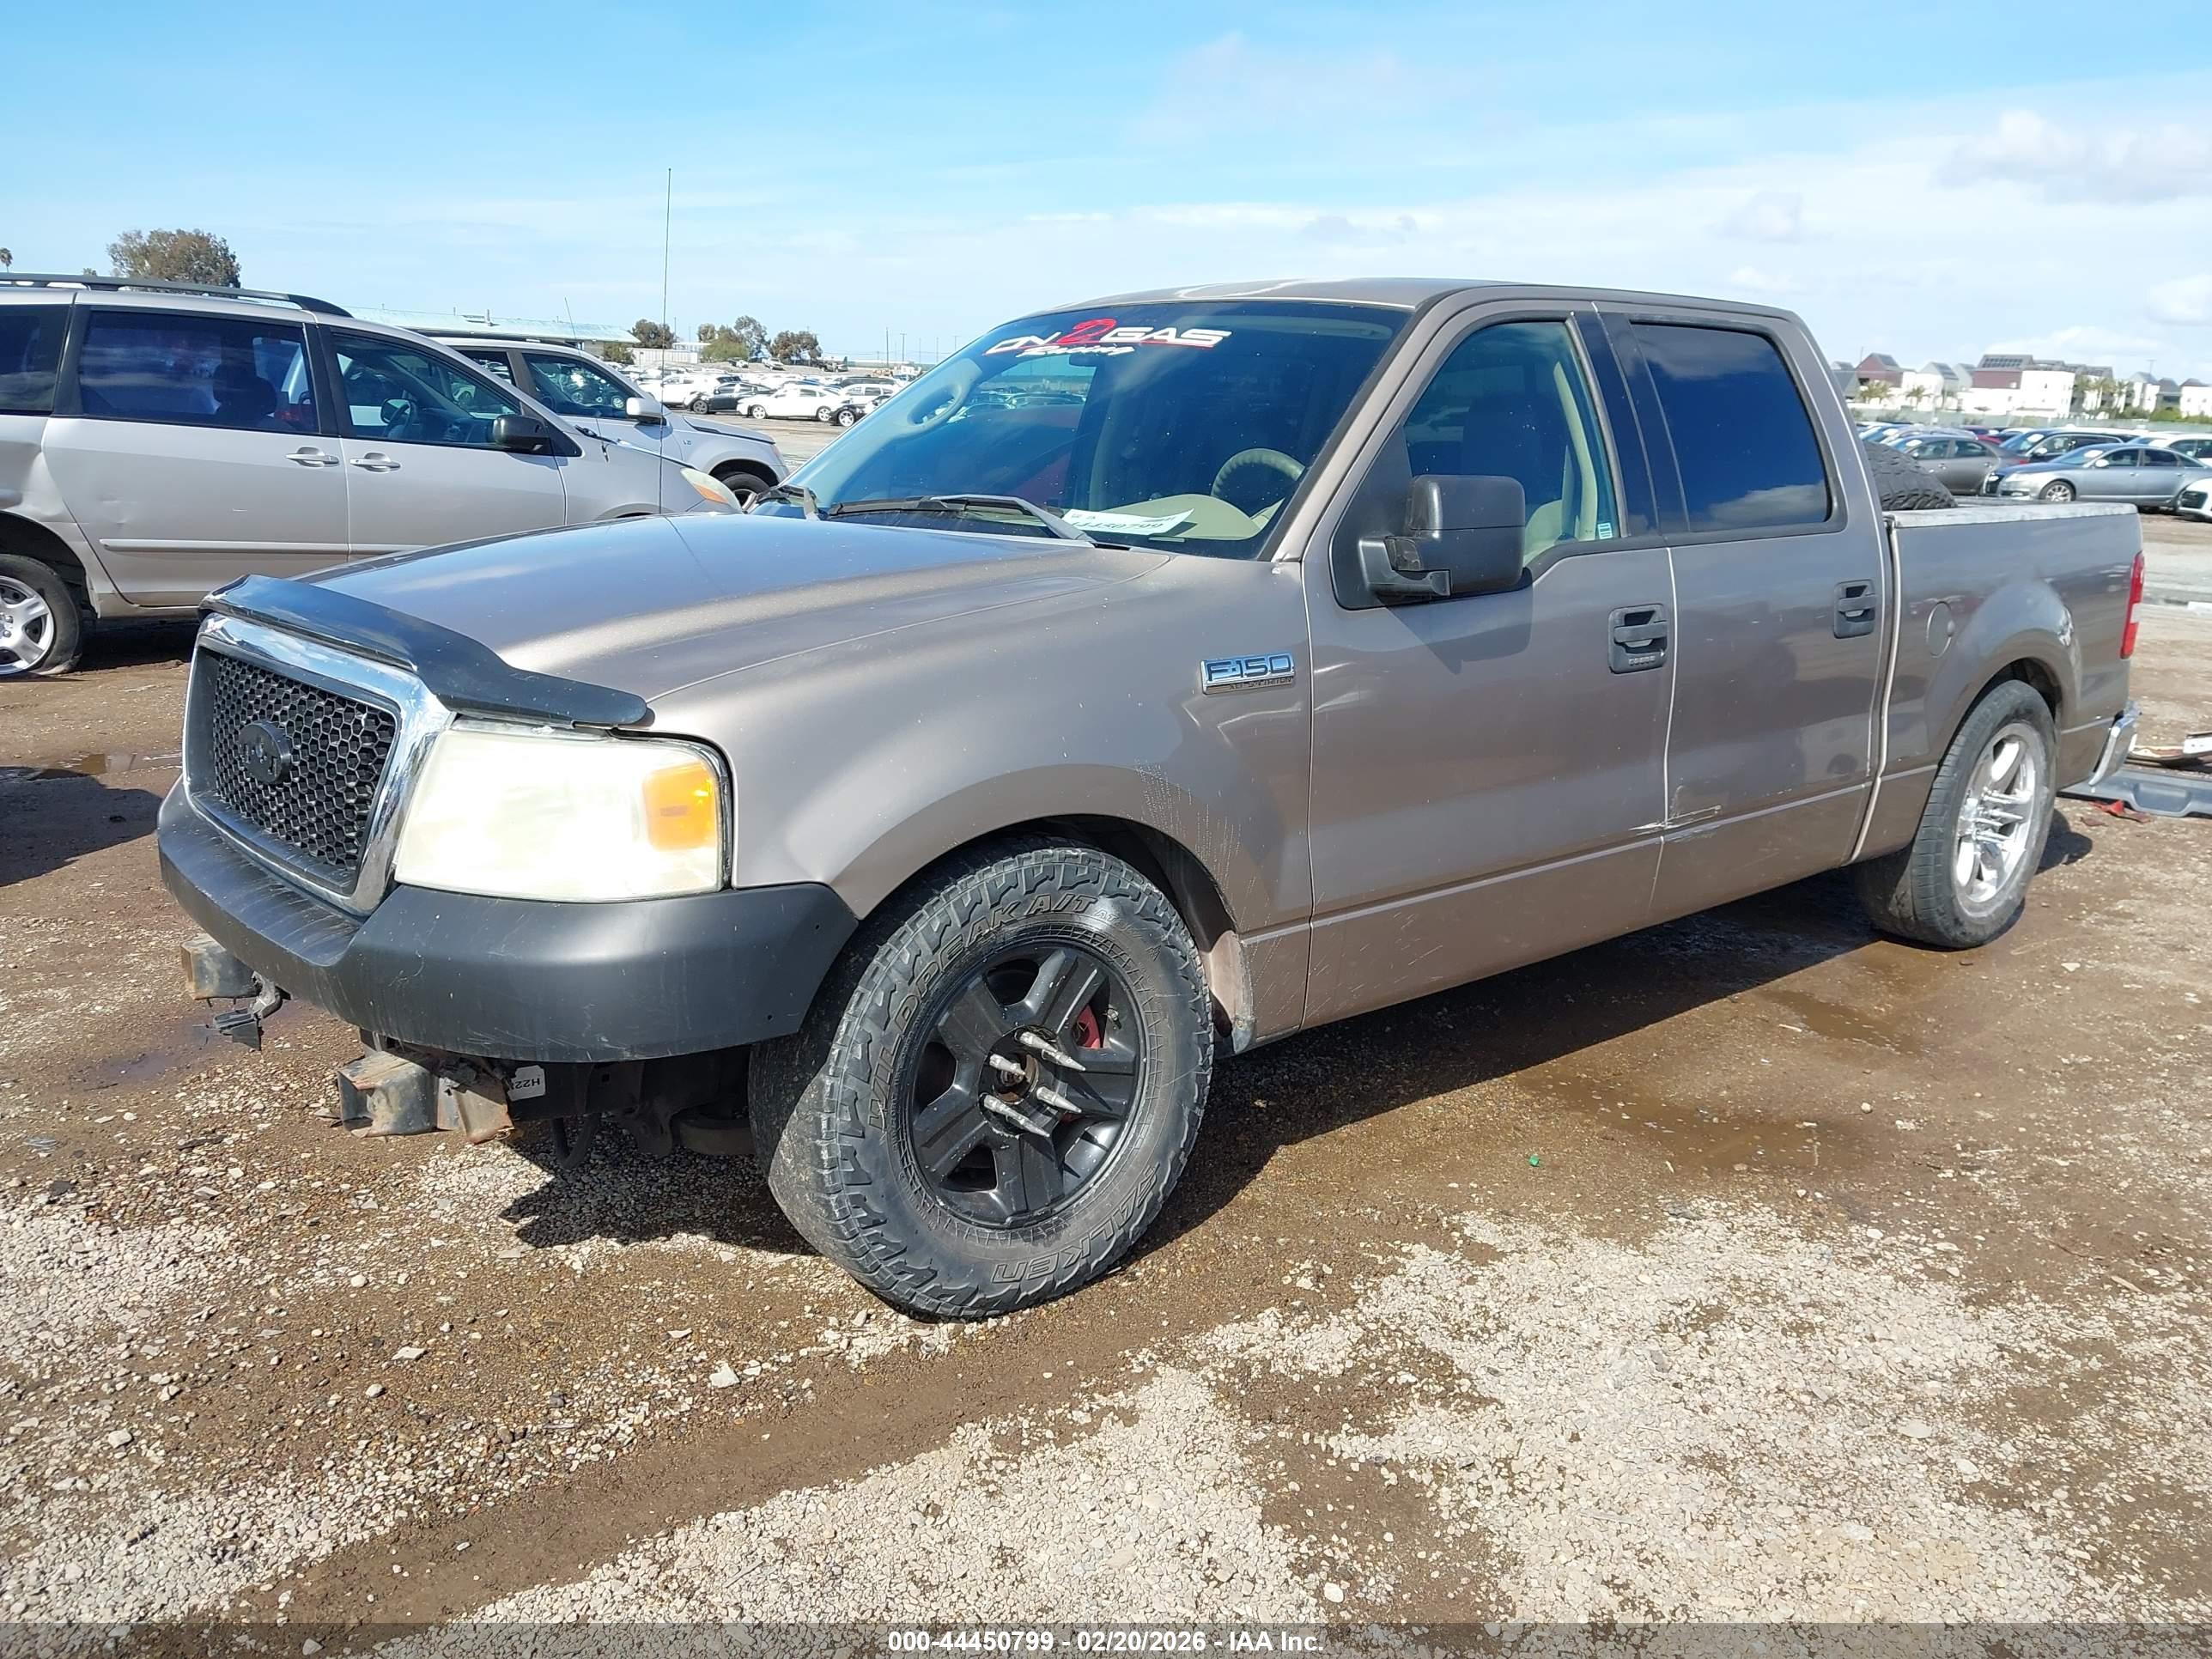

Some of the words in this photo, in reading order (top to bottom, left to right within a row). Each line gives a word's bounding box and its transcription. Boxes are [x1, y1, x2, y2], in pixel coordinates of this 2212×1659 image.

[1206, 654, 1291, 681] F-150
[868, 901, 1021, 1130] WILDPEAK
[1030, 893, 1098, 915] A/T
[990, 1161, 1160, 1284] FALKEN
